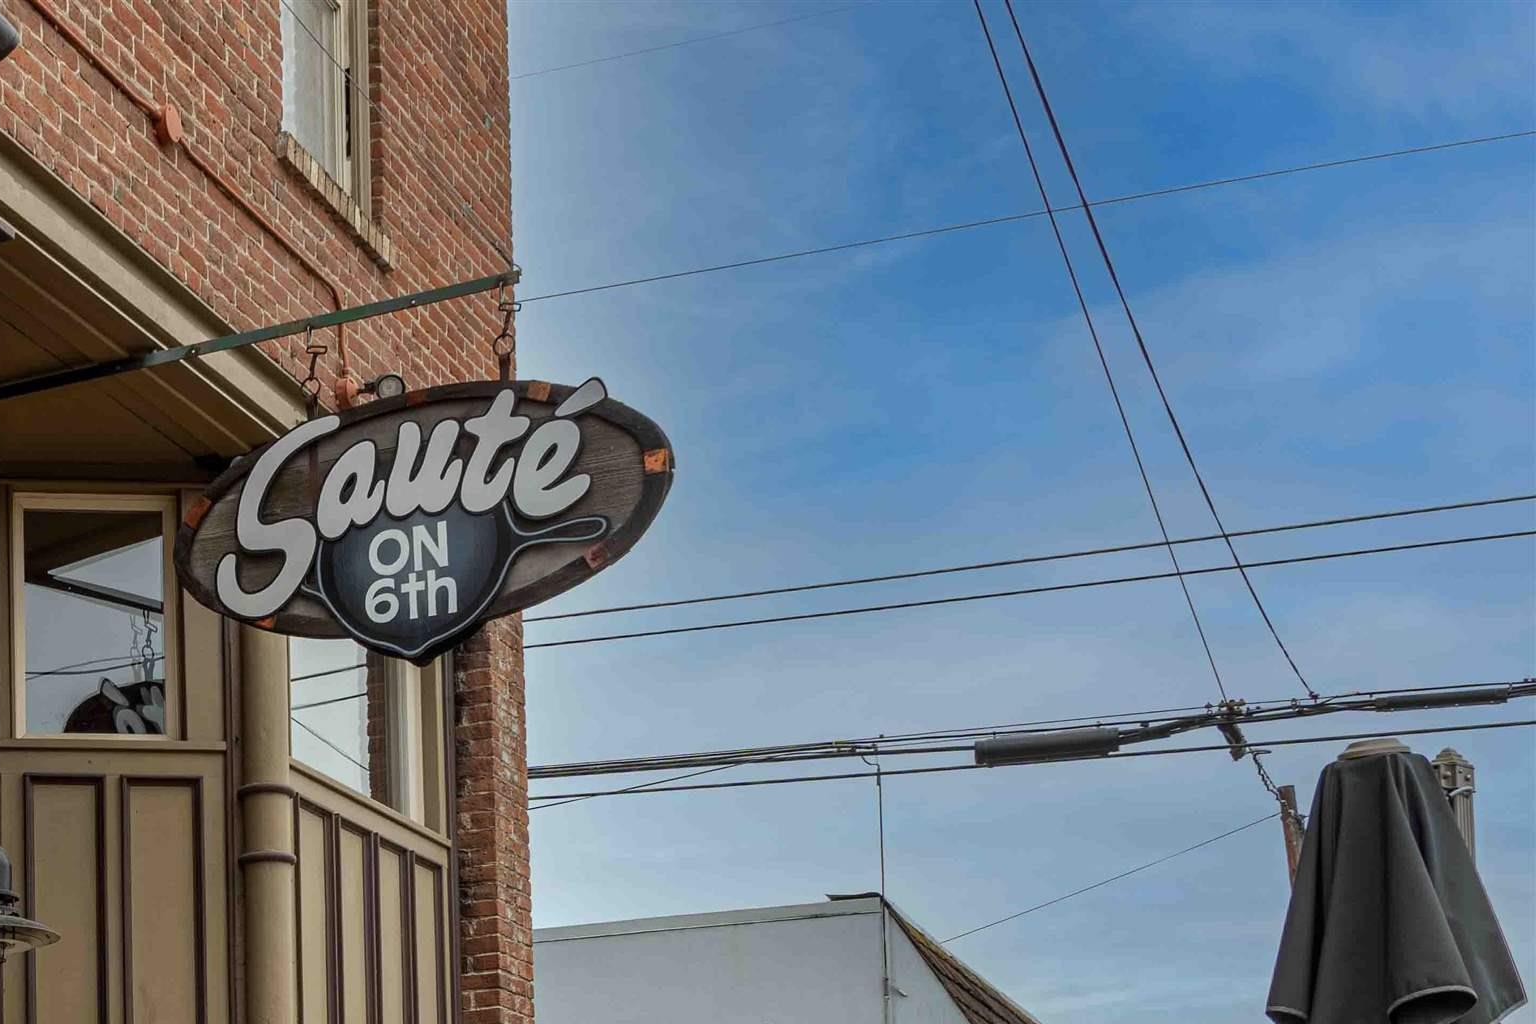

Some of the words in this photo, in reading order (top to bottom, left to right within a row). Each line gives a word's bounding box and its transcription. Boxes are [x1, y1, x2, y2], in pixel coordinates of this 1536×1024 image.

[216, 377, 606, 618] Sauté
[368, 520, 449, 576] ON
[365, 569, 459, 624] 6th
